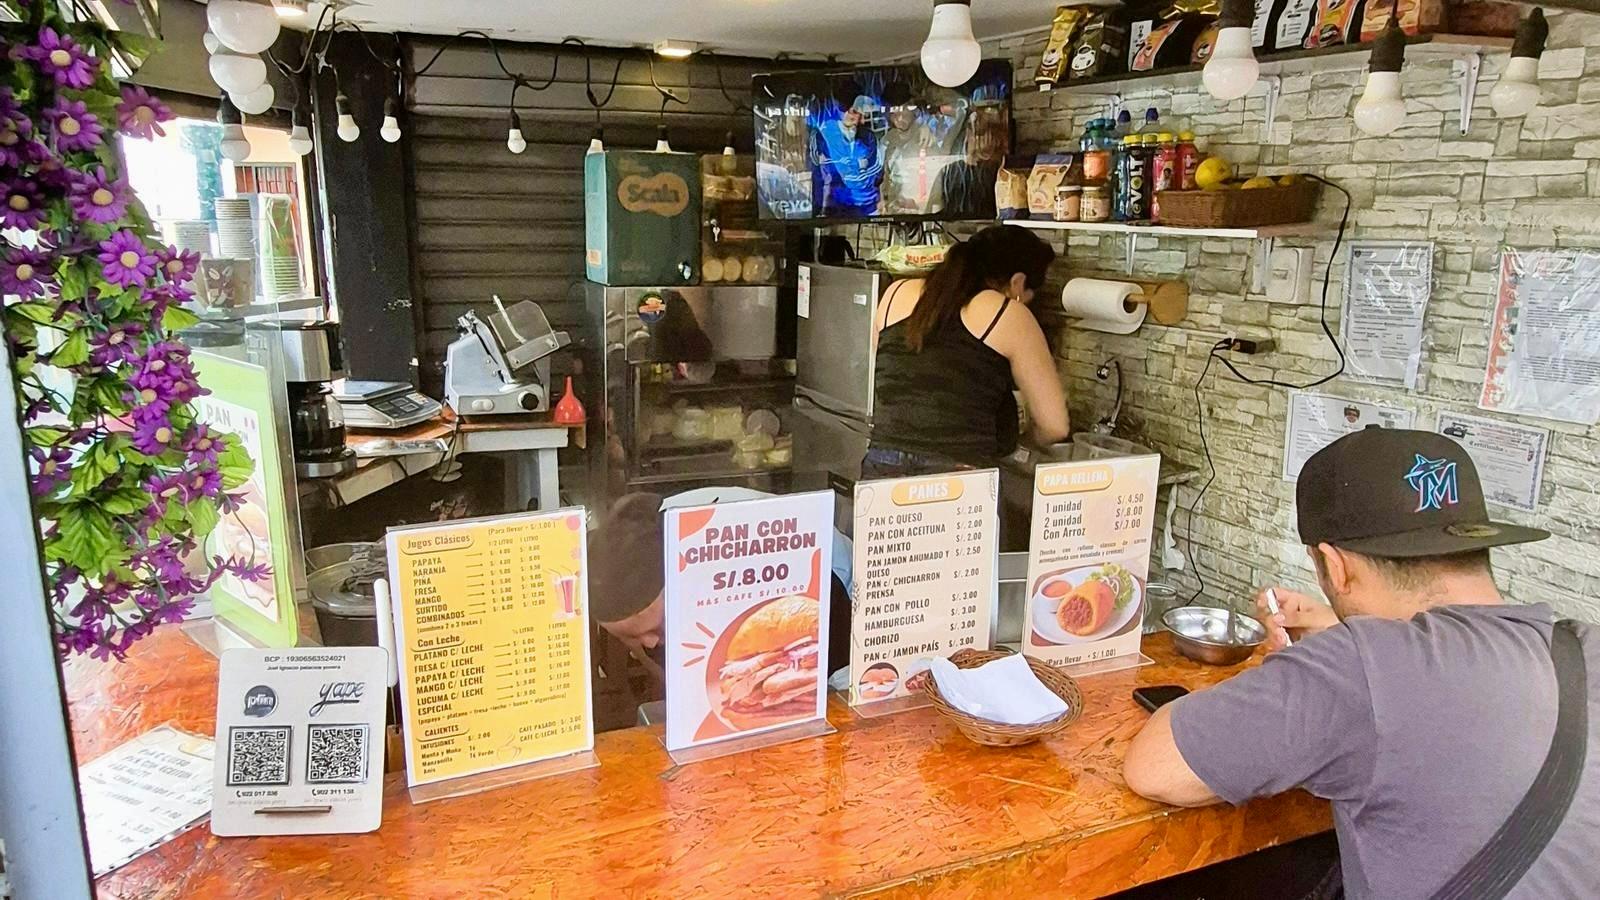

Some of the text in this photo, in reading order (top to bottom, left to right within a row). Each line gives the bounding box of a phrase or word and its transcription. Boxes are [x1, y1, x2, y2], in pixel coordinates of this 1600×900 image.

[1043, 473, 1069, 487] PAPA
[908, 482, 949, 500] PANES
[1052, 500, 1082, 513] unidad
[869, 515, 886, 527] PAN
[896, 512, 923, 524] QUESO
[1044, 514, 1082, 528] 2 unidad
[706, 518, 798, 544] PAN CON
[868, 523, 946, 542] PAN CON ACEITUNA
[1043, 527, 1086, 541] Con Arroz
[407, 540, 432, 550] Jugos
[685, 532, 816, 564] CHICHARRON
[867, 542, 912, 556] PAN MIXTO
[412, 557, 442, 568] PAPAYA
[867, 550, 950, 568] PAN JAMON AHUMADO Y
[412, 566, 447, 577] NARANJA
[866, 568, 890, 580] QUESO
[866, 578, 882, 590] PAN
[893, 572, 941, 585] CHICHARRON
[414, 586, 437, 596] FRESA
[866, 588, 895, 600] PRENSA
[415, 595, 442, 606] MANGO
[865, 598, 930, 616] PAN CON POLLO
[416, 604, 448, 616] SURTIDO
[416, 610, 465, 624] COMBINADOS
[864, 614, 925, 631] HAMBURGUESA
[418, 634, 460, 648] Con Leche
[864, 633, 900, 647] CHORIZO
[414, 650, 448, 661] PLATANO
[462, 644, 483, 654] LECHE
[863, 650, 880, 663] PAN
[892, 645, 919, 657] JAMON
[414, 663, 438, 674] FRESA
[451, 657, 474, 668] LECHE
[416, 672, 447, 684] PAPAYA
[462, 666, 485, 676] LECHE
[416, 682, 446, 694] MANGO
[460, 676, 483, 687] LECHE
[417, 694, 448, 706] LUCUMA
[462, 688, 484, 698] LECHE
[418, 704, 452, 716] ESPECIAL
[424, 724, 459, 736] CALIENTES
[420, 738, 455, 750] INFUSIONES
